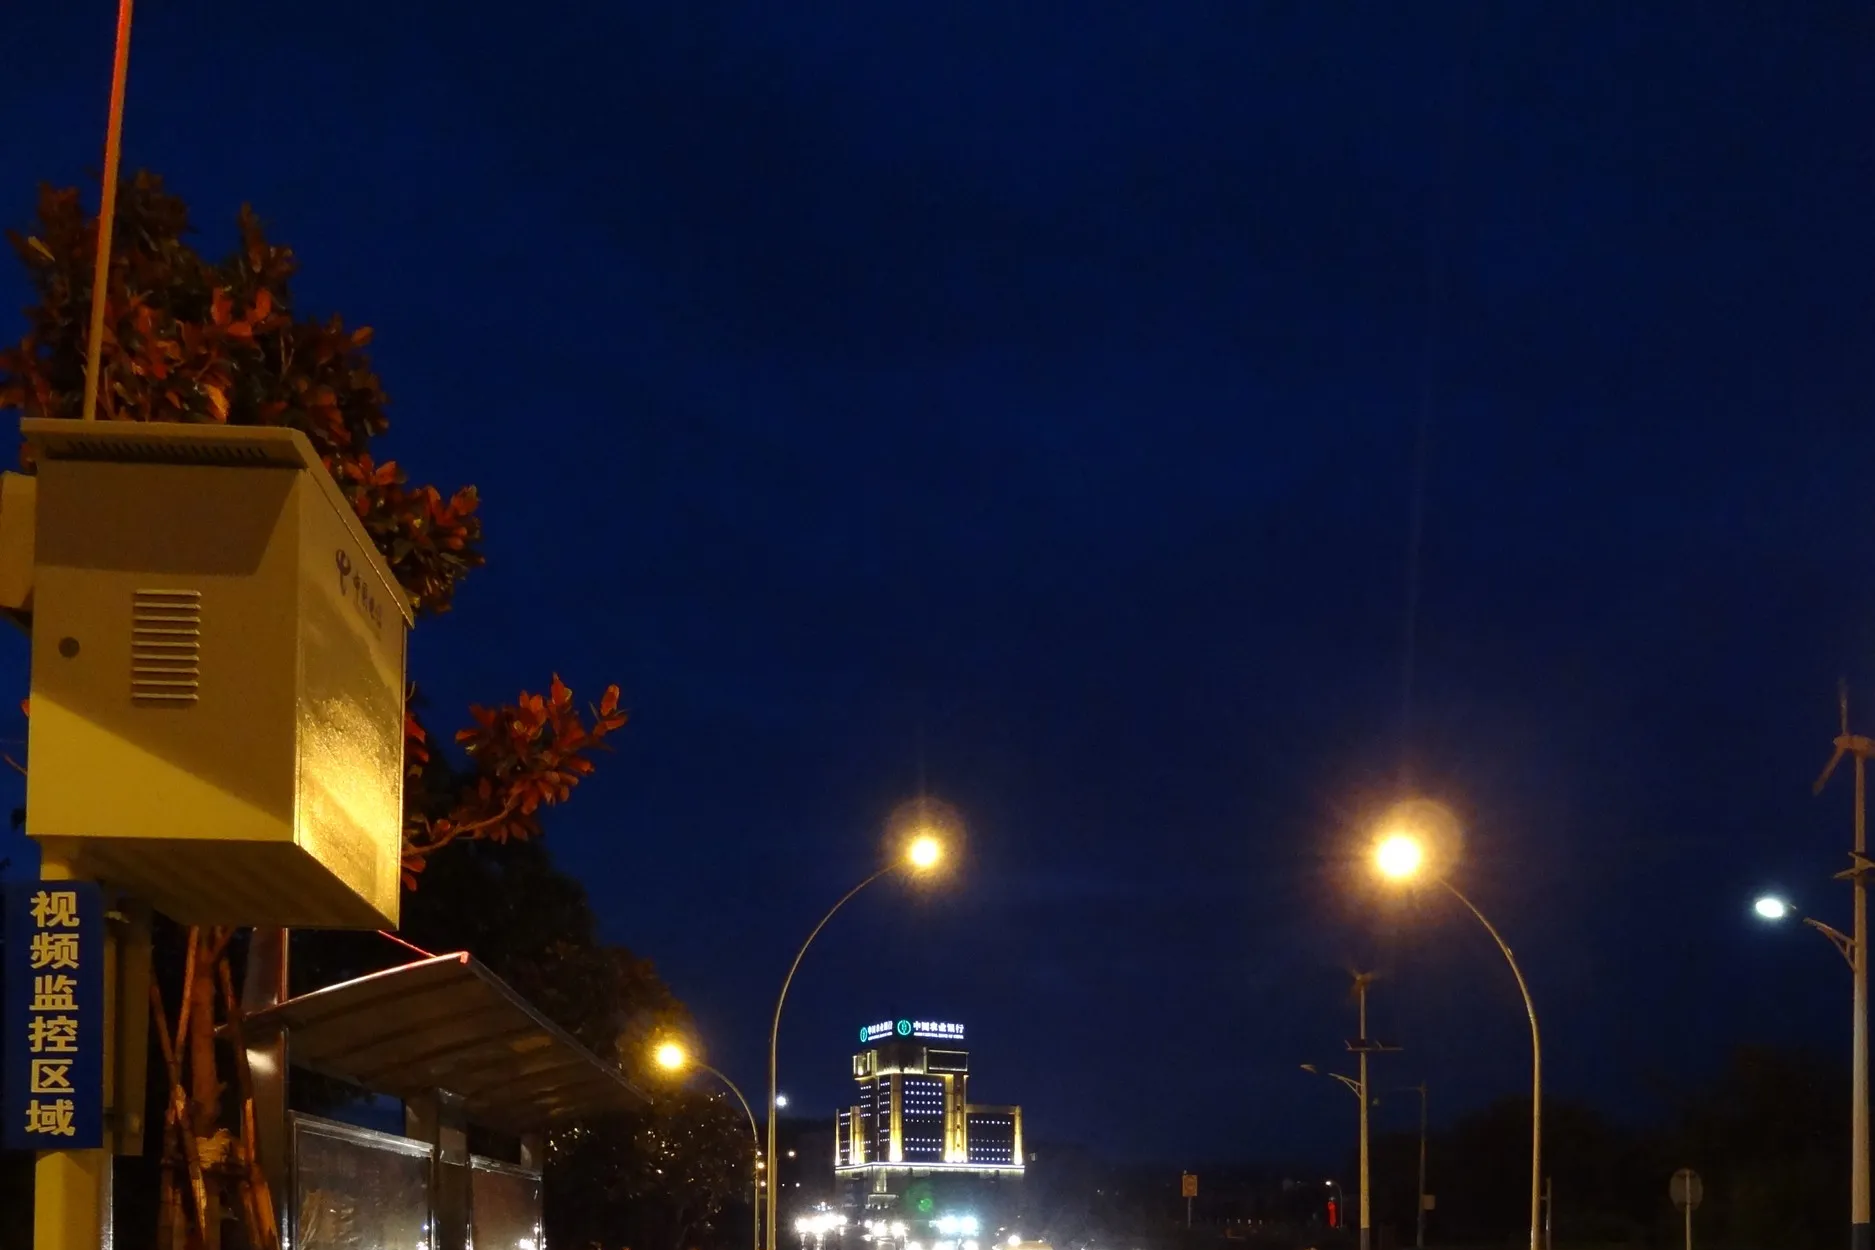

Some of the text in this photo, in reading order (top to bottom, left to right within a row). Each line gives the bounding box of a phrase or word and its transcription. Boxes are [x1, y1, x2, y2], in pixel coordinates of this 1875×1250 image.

[25, 890, 81, 1137] 视频监控区域
[913, 1020, 964, 1034] 中国农业银行
